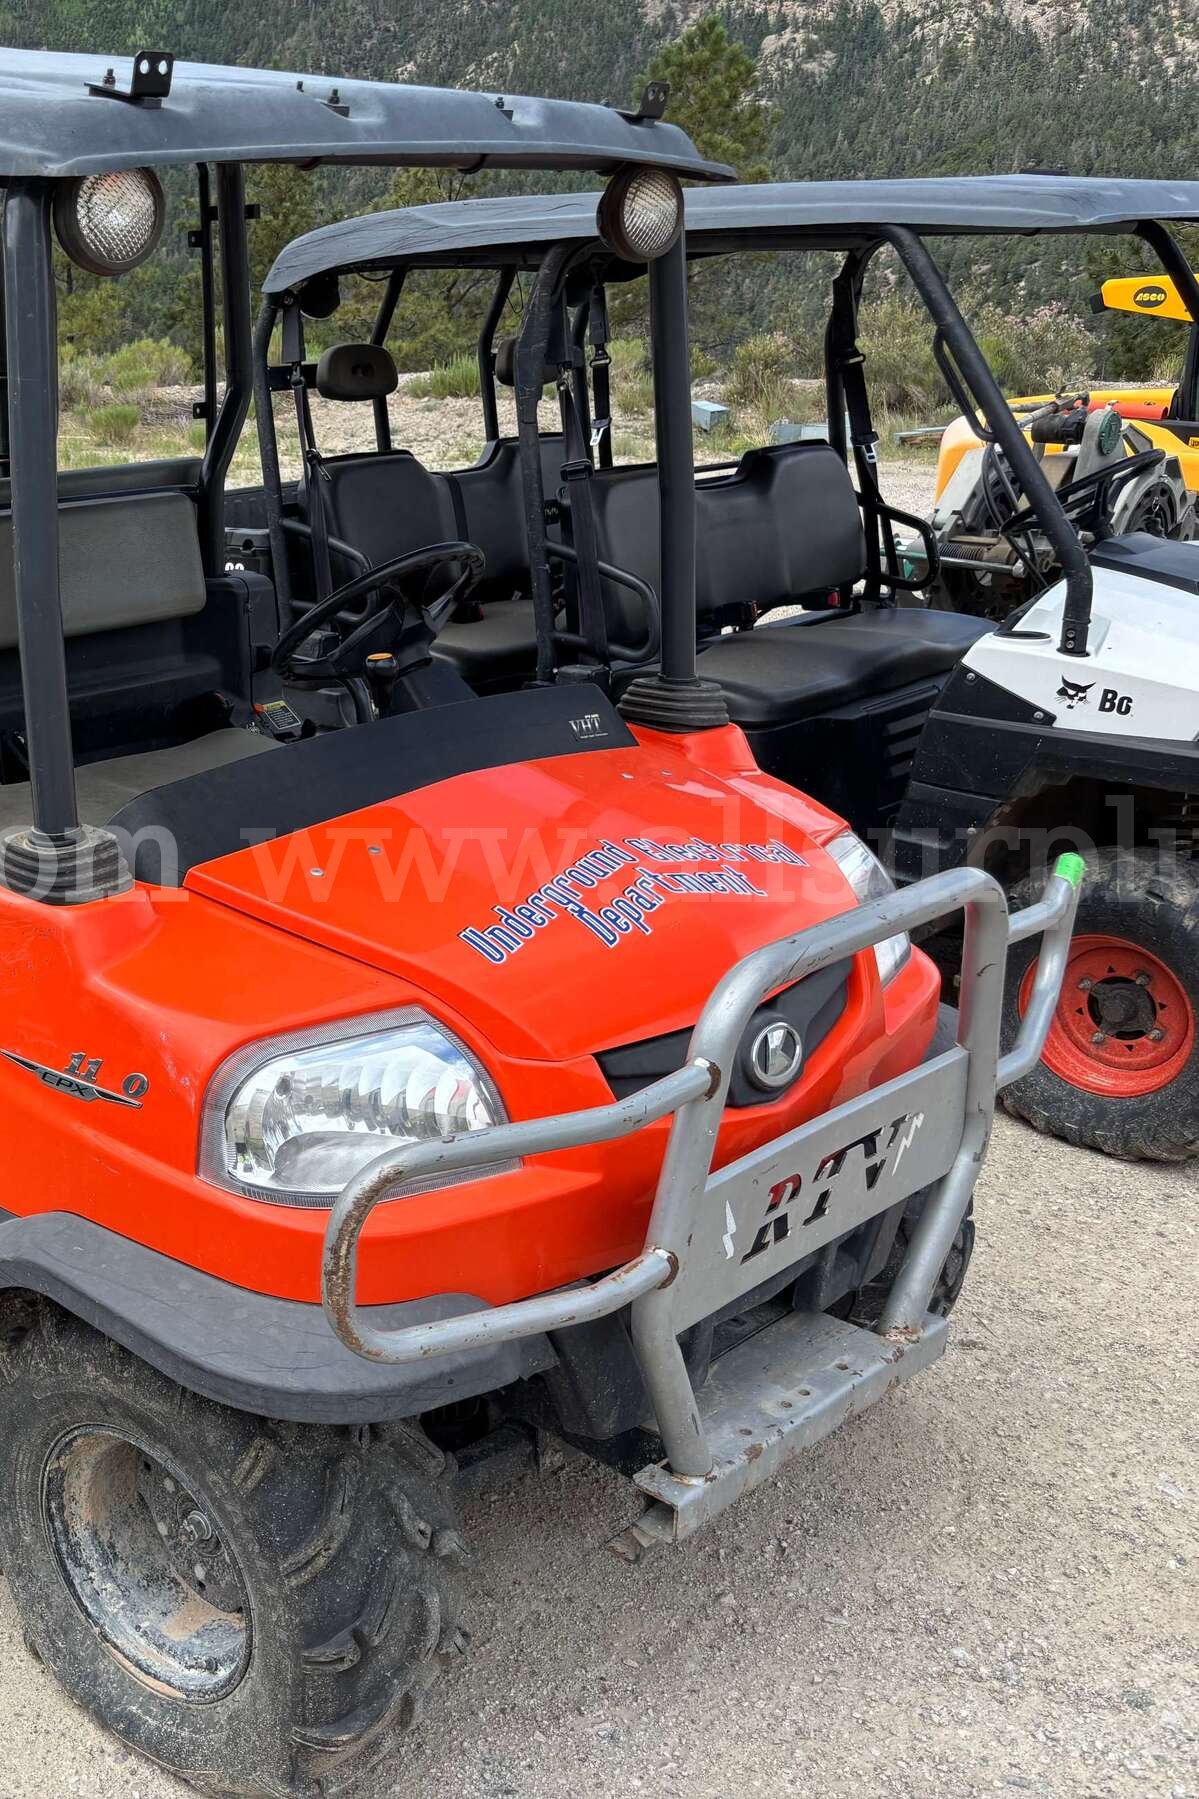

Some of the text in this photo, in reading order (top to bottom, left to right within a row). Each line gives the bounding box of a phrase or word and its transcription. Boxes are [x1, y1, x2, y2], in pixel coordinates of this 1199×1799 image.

[457, 839, 639, 965] Underground
[563, 864, 769, 949] Department
[41, 1070, 89, 1098] CPX
